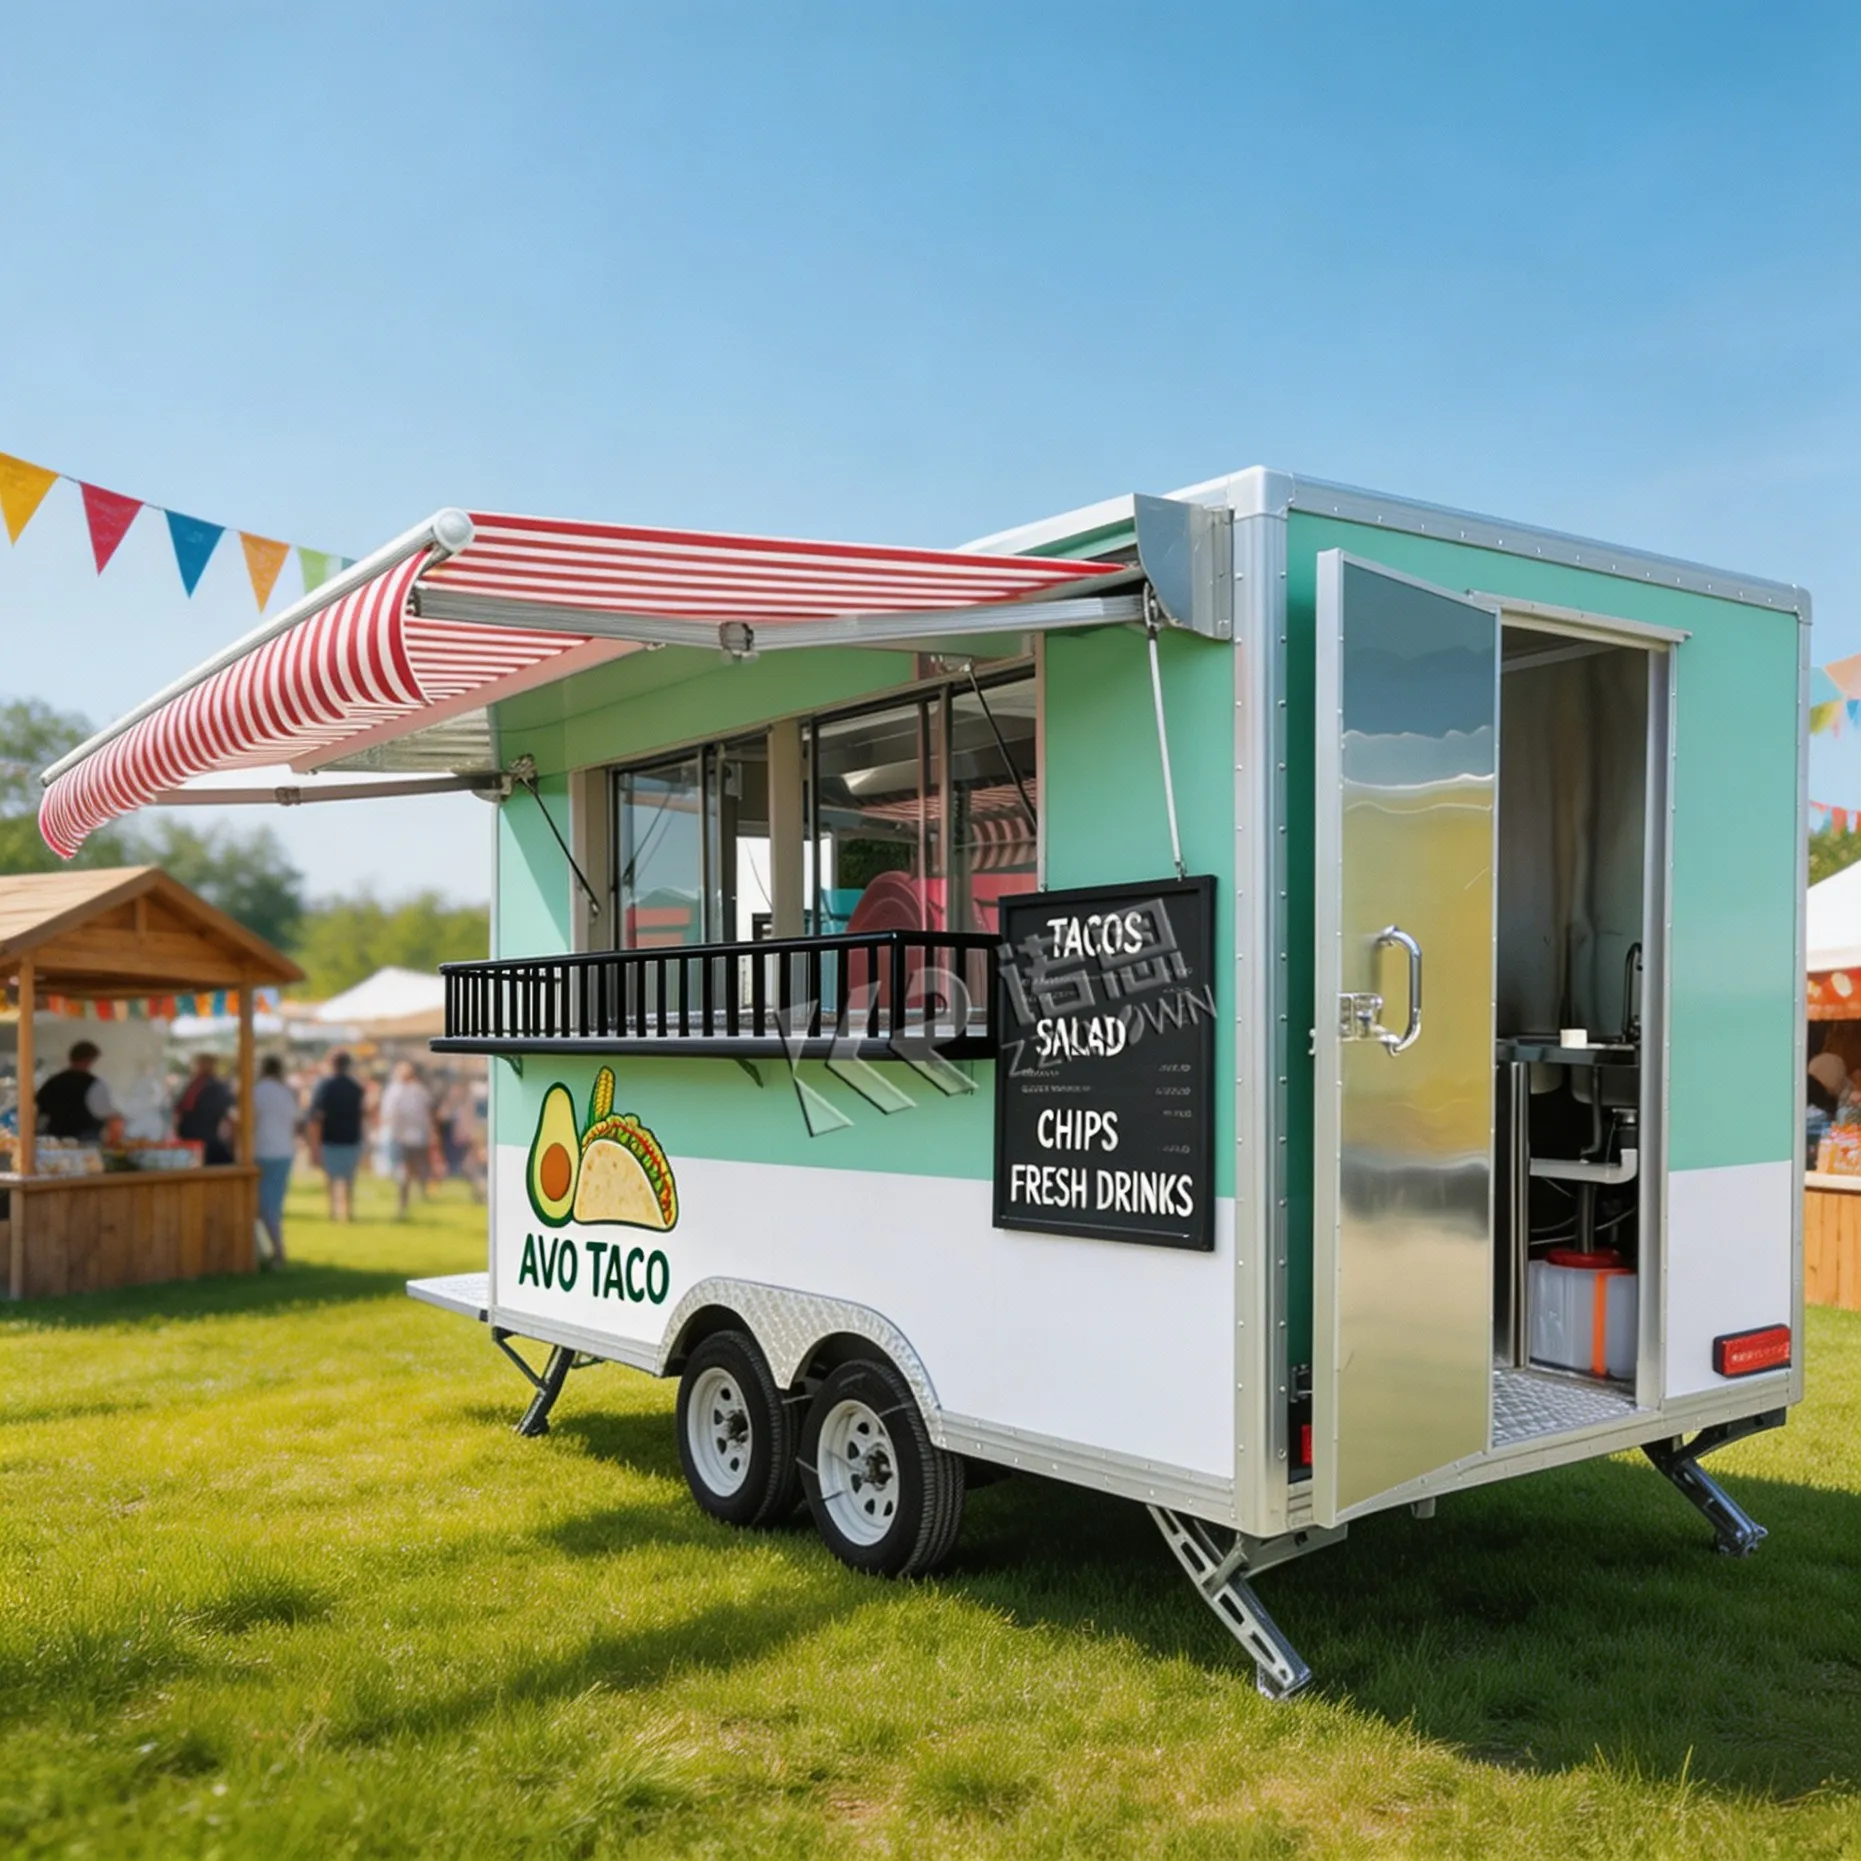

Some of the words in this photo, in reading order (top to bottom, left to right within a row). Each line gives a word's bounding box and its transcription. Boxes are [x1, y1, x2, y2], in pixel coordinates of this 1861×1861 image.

[1047, 911, 1143, 958] TACOS
[1036, 1016, 1126, 1057] SALAD
[1037, 1109, 1119, 1152] CHIPS
[1010, 1164, 1087, 1210] FRESH
[1096, 1170, 1194, 1217] DRINKS
[518, 1233, 578, 1292] AVO
[586, 1241, 670, 1305] TACO
